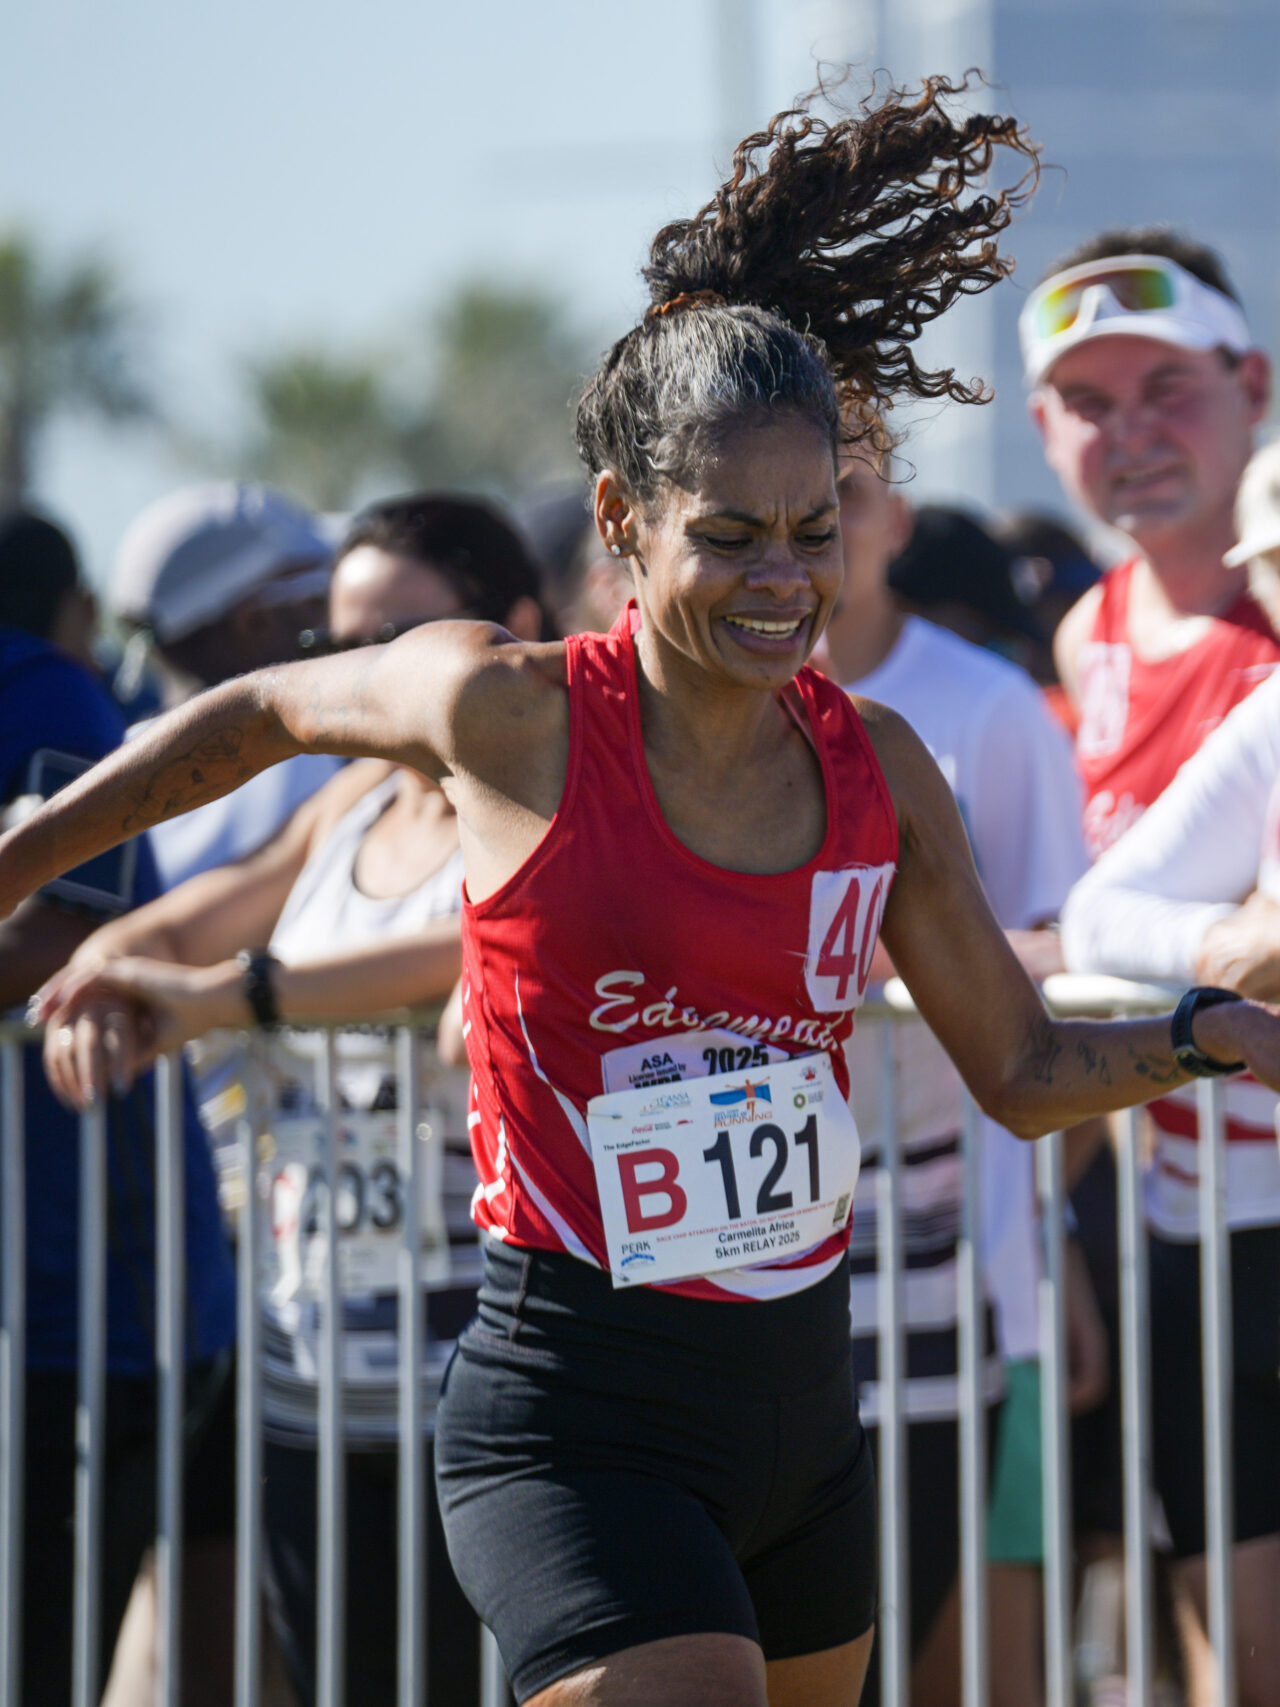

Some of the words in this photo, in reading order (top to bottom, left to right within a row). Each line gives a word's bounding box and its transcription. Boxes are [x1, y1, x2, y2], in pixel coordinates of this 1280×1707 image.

[815, 876, 884, 1001] 40
[641, 1052, 674, 1072] ASA
[702, 1044, 769, 1077] 2025
[703, 1114, 820, 1221] 121
[616, 1147, 688, 1234] B
[621, 1240, 651, 1255] PEAK
[715, 1246, 741, 1260] 5km
[742, 1236, 777, 1254] RELAY
[777, 1231, 801, 1247] 2025
[718, 1225, 767, 1244] Carmelita
[768, 1219, 795, 1234] Africa
